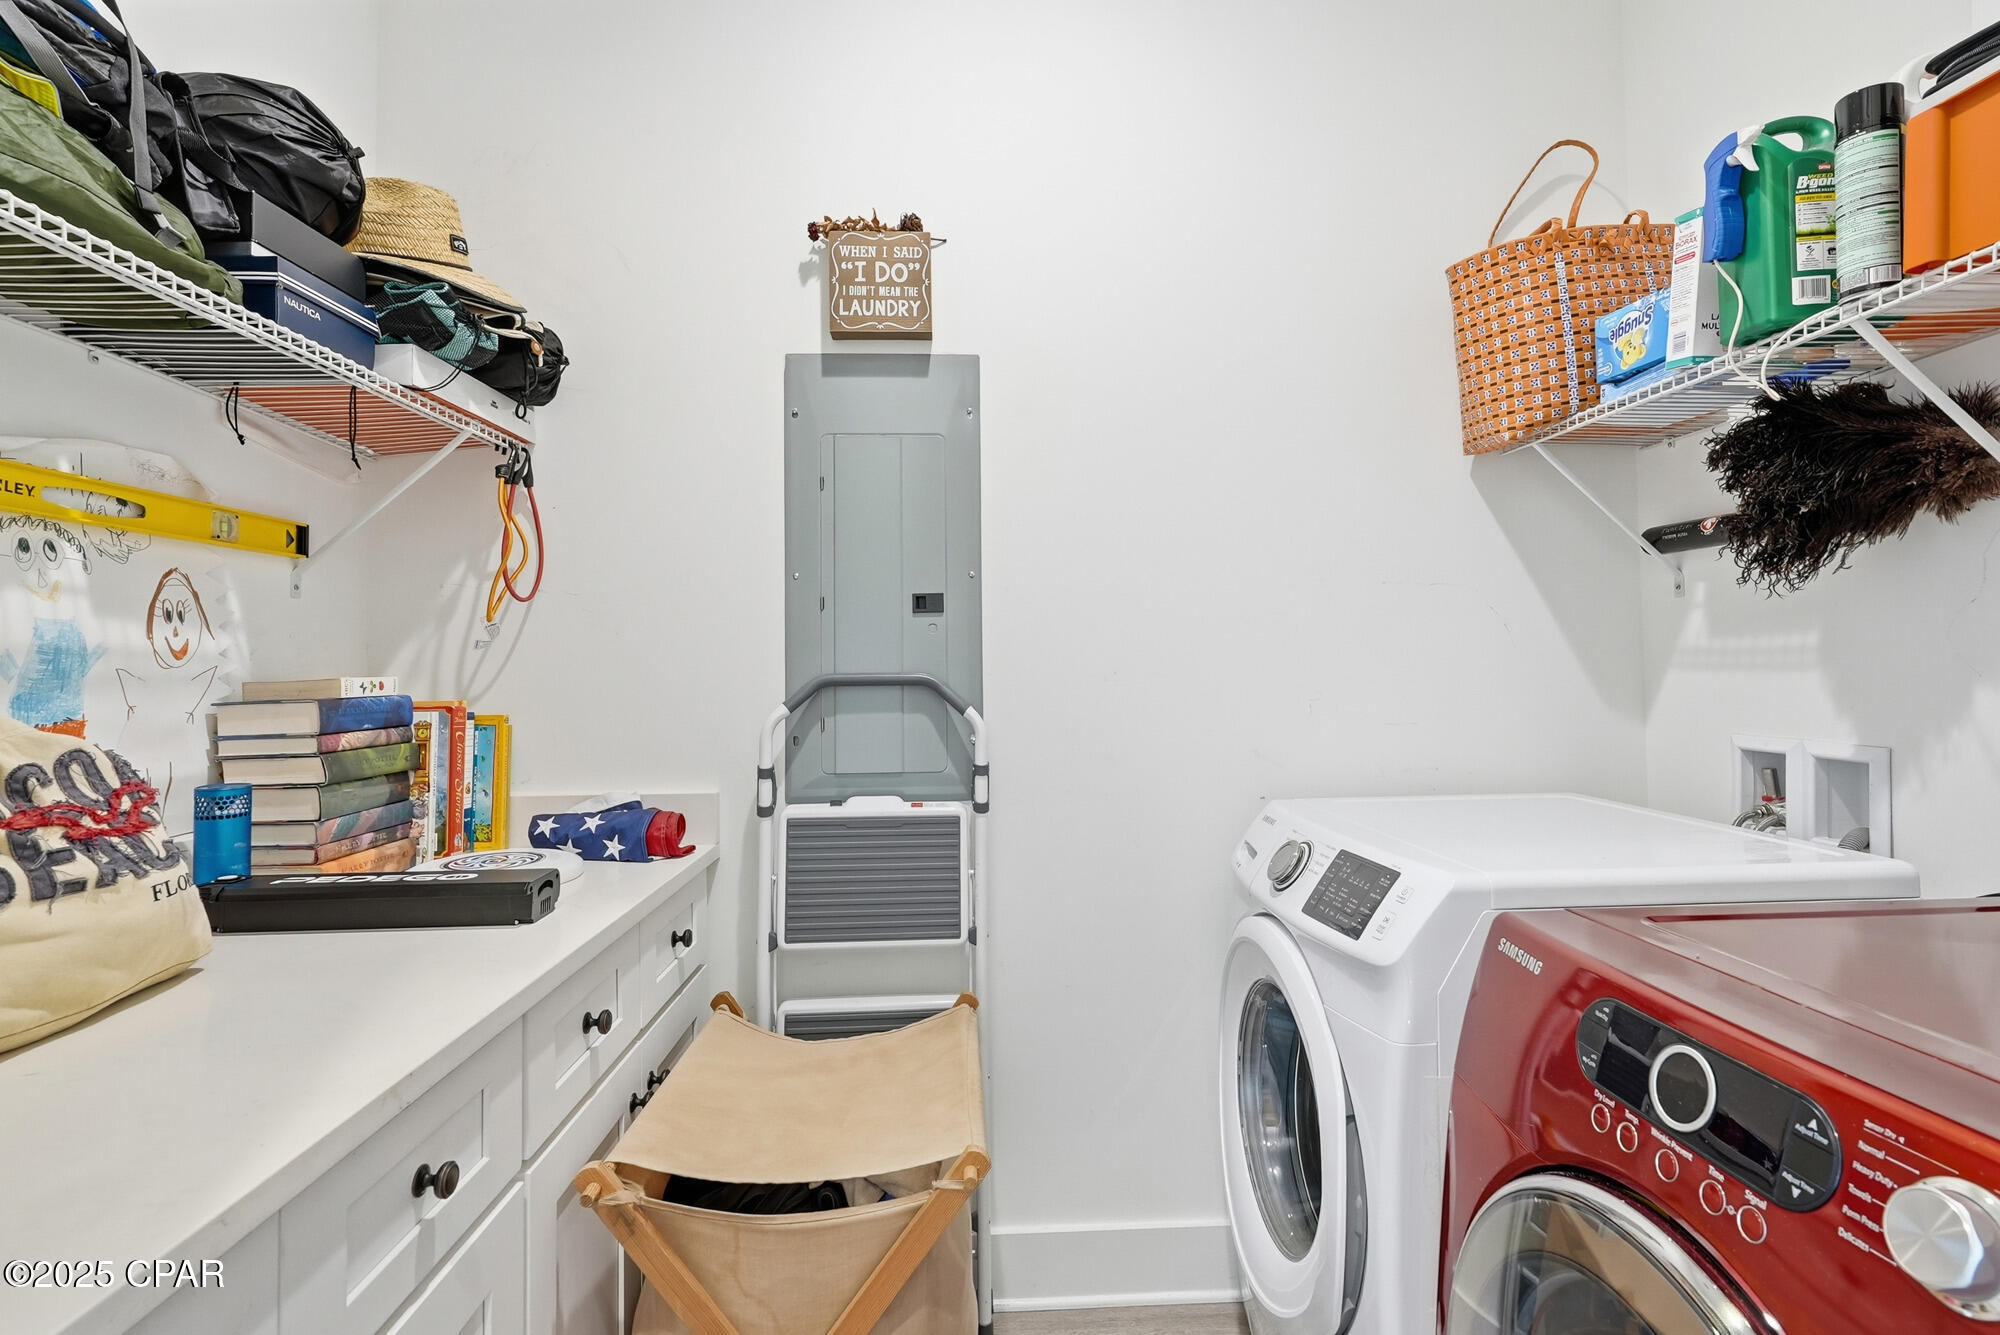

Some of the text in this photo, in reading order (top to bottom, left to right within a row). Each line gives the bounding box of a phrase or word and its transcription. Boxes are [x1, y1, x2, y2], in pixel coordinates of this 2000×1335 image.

[839, 245, 923, 259] WHEN I SAID
[1675, 236, 1698, 250] BORAX
[842, 285, 919, 297] I DIDN'T MEAN THE
[283, 295, 322, 321] NAUTICA
[839, 298, 922, 317] LAUNDRY
[1609, 304, 1654, 343] Snuggle
[0, 479, 36, 497] LEY
[455, 731, 465, 773] Classic
[454, 778, 465, 824] Stories
[269, 872, 479, 885] PEDEGO
[1498, 937, 1543, 976] SAMSUNG
[1813, 1131, 1829, 1145] Time
[1864, 1119, 1897, 1140] Sensor Dry
[1857, 1139, 1885, 1159] Normal
[1708, 1164, 1725, 1183] Time
[1852, 1160, 1894, 1189] Heavy Duty
[1800, 1180, 1815, 1195] Time
[1848, 1182, 1872, 1203] Towels
[1744, 1189, 1767, 1211] Signal
[1842, 1204, 1880, 1233] Perm Press
[1837, 1226, 1870, 1252] Delicates
